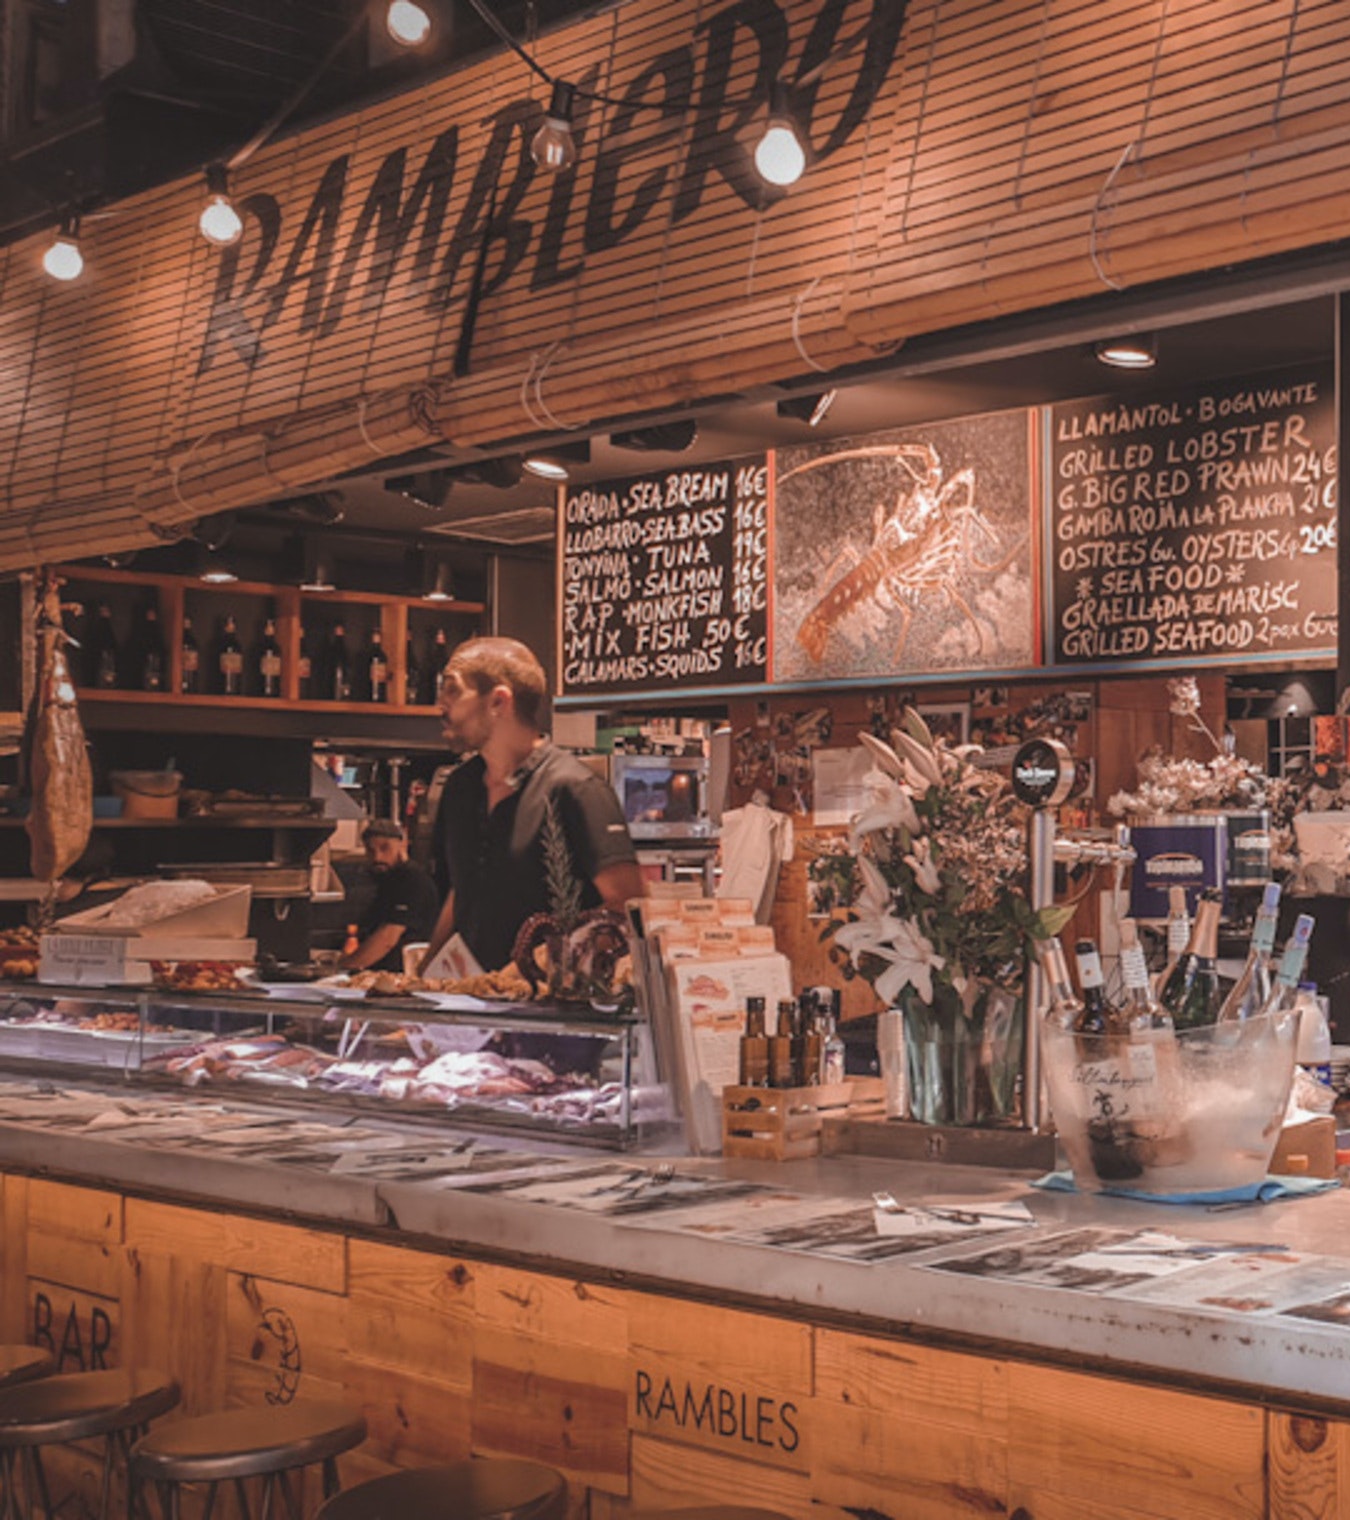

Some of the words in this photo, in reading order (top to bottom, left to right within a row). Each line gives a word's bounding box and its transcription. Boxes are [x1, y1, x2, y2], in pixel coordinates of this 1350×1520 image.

[1198, 382, 1318, 421] BOGAVANTE
[1167, 415, 1311, 464] LOBSTER
[664, 472, 729, 508] BREAM
[1133, 469, 1190, 501] RED
[1198, 454, 1289, 492] PRAWN
[646, 541, 711, 571] TUNA
[1059, 538, 1148, 572] OSTRES
[1181, 528, 1280, 564] OYSTERS
[642, 565, 723, 598] SALMON
[565, 604, 614, 633] RAP
[34, 1291, 112, 1374] BAR
[635, 1369, 801, 1453] RAMBLES
